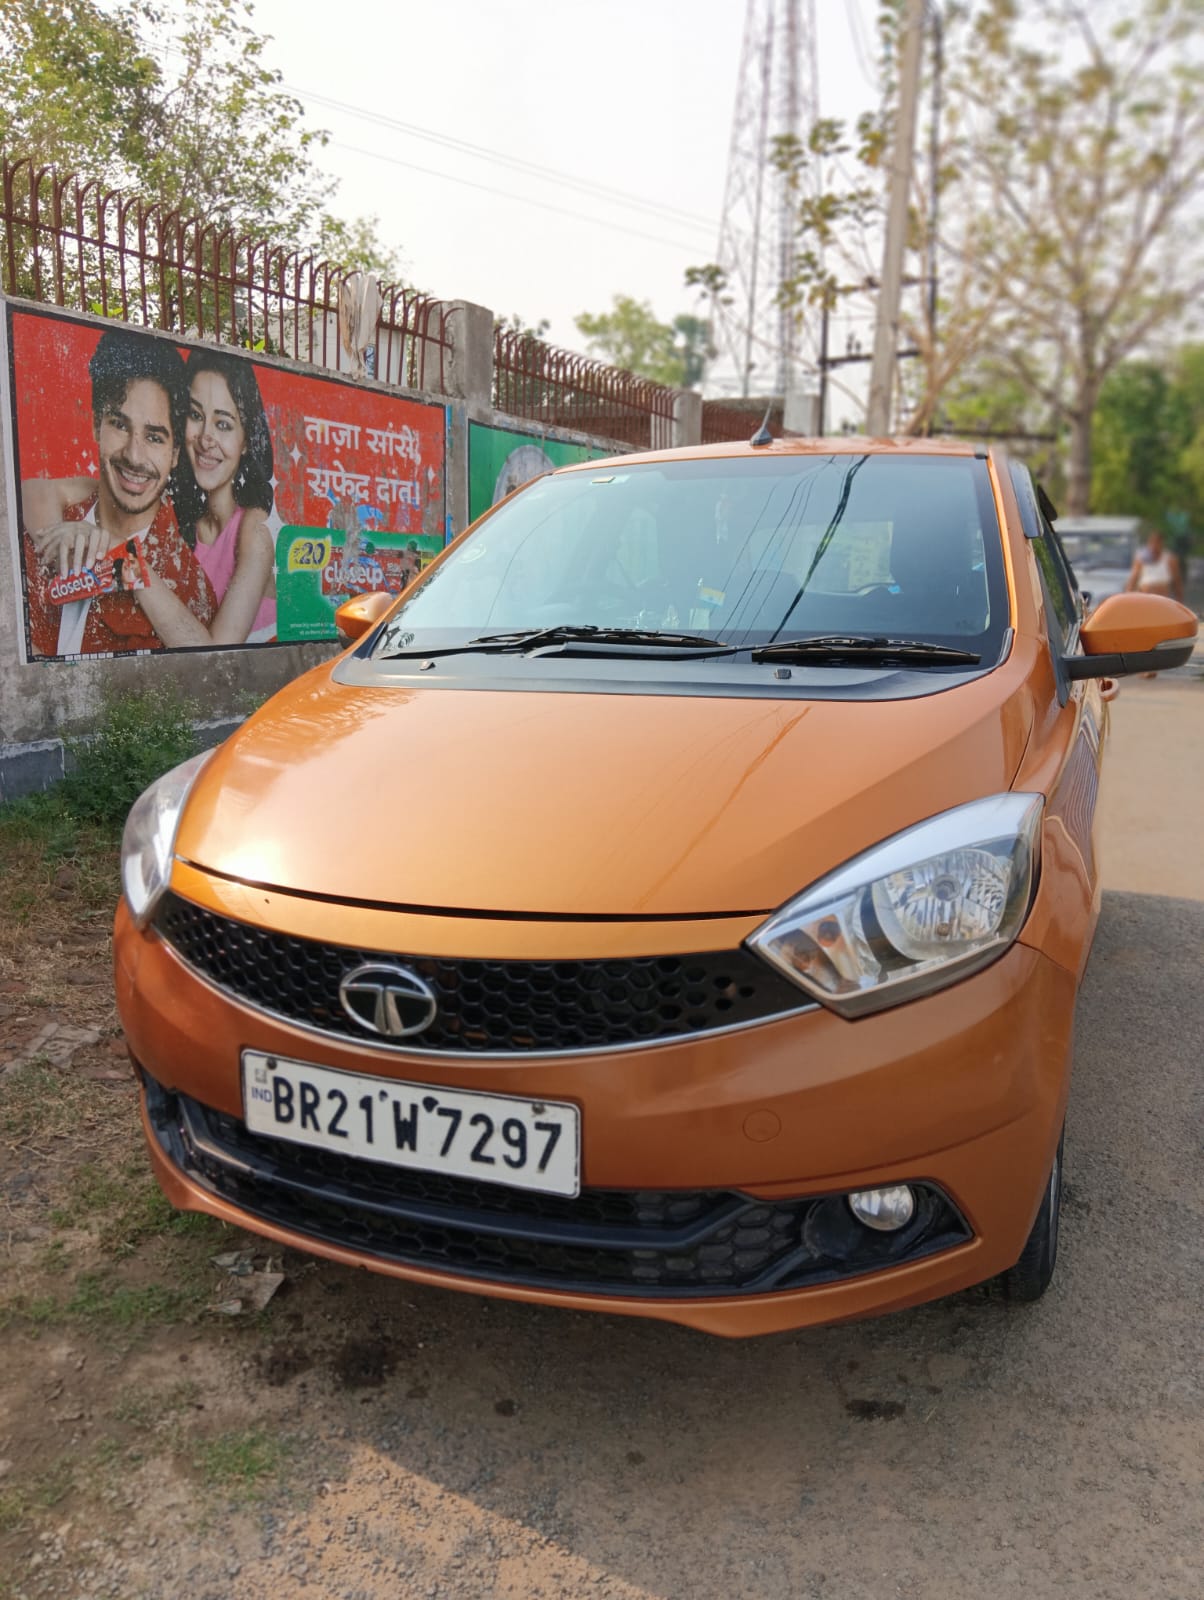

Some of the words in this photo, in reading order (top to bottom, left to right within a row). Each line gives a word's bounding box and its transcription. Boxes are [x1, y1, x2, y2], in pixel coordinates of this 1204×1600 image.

[303, 416, 361, 454] ताज़ा
[50, 574, 95, 599] closeup
[251, 1087, 273, 1103] IND
